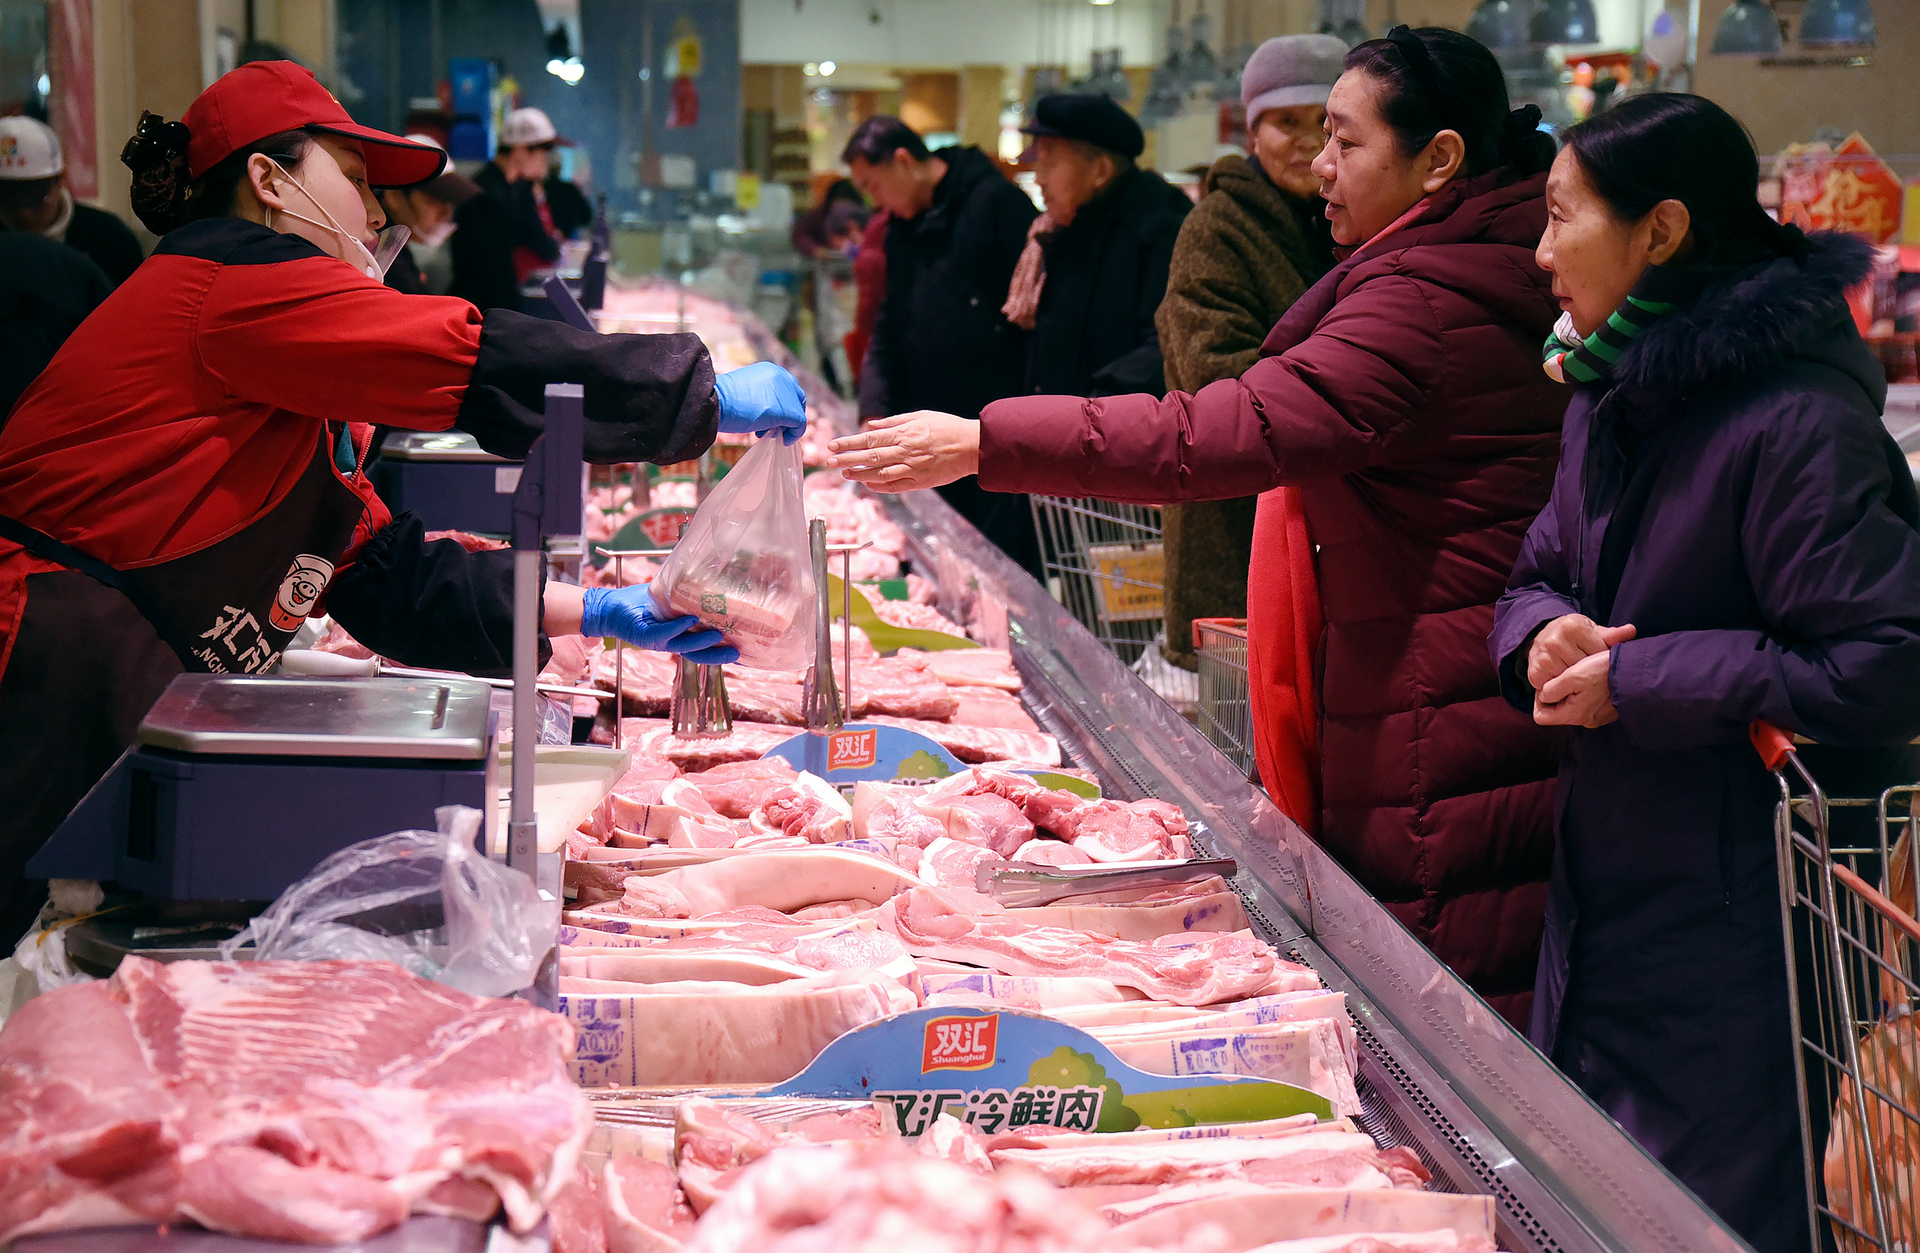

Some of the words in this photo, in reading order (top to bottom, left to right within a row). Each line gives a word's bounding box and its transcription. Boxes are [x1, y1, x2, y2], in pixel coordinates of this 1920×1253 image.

[834, 734, 870, 759] 双汇
[833, 756, 869, 765] Shuanghui
[932, 1021, 989, 1055] 双汇
[931, 1052, 985, 1064] Shuanghui
